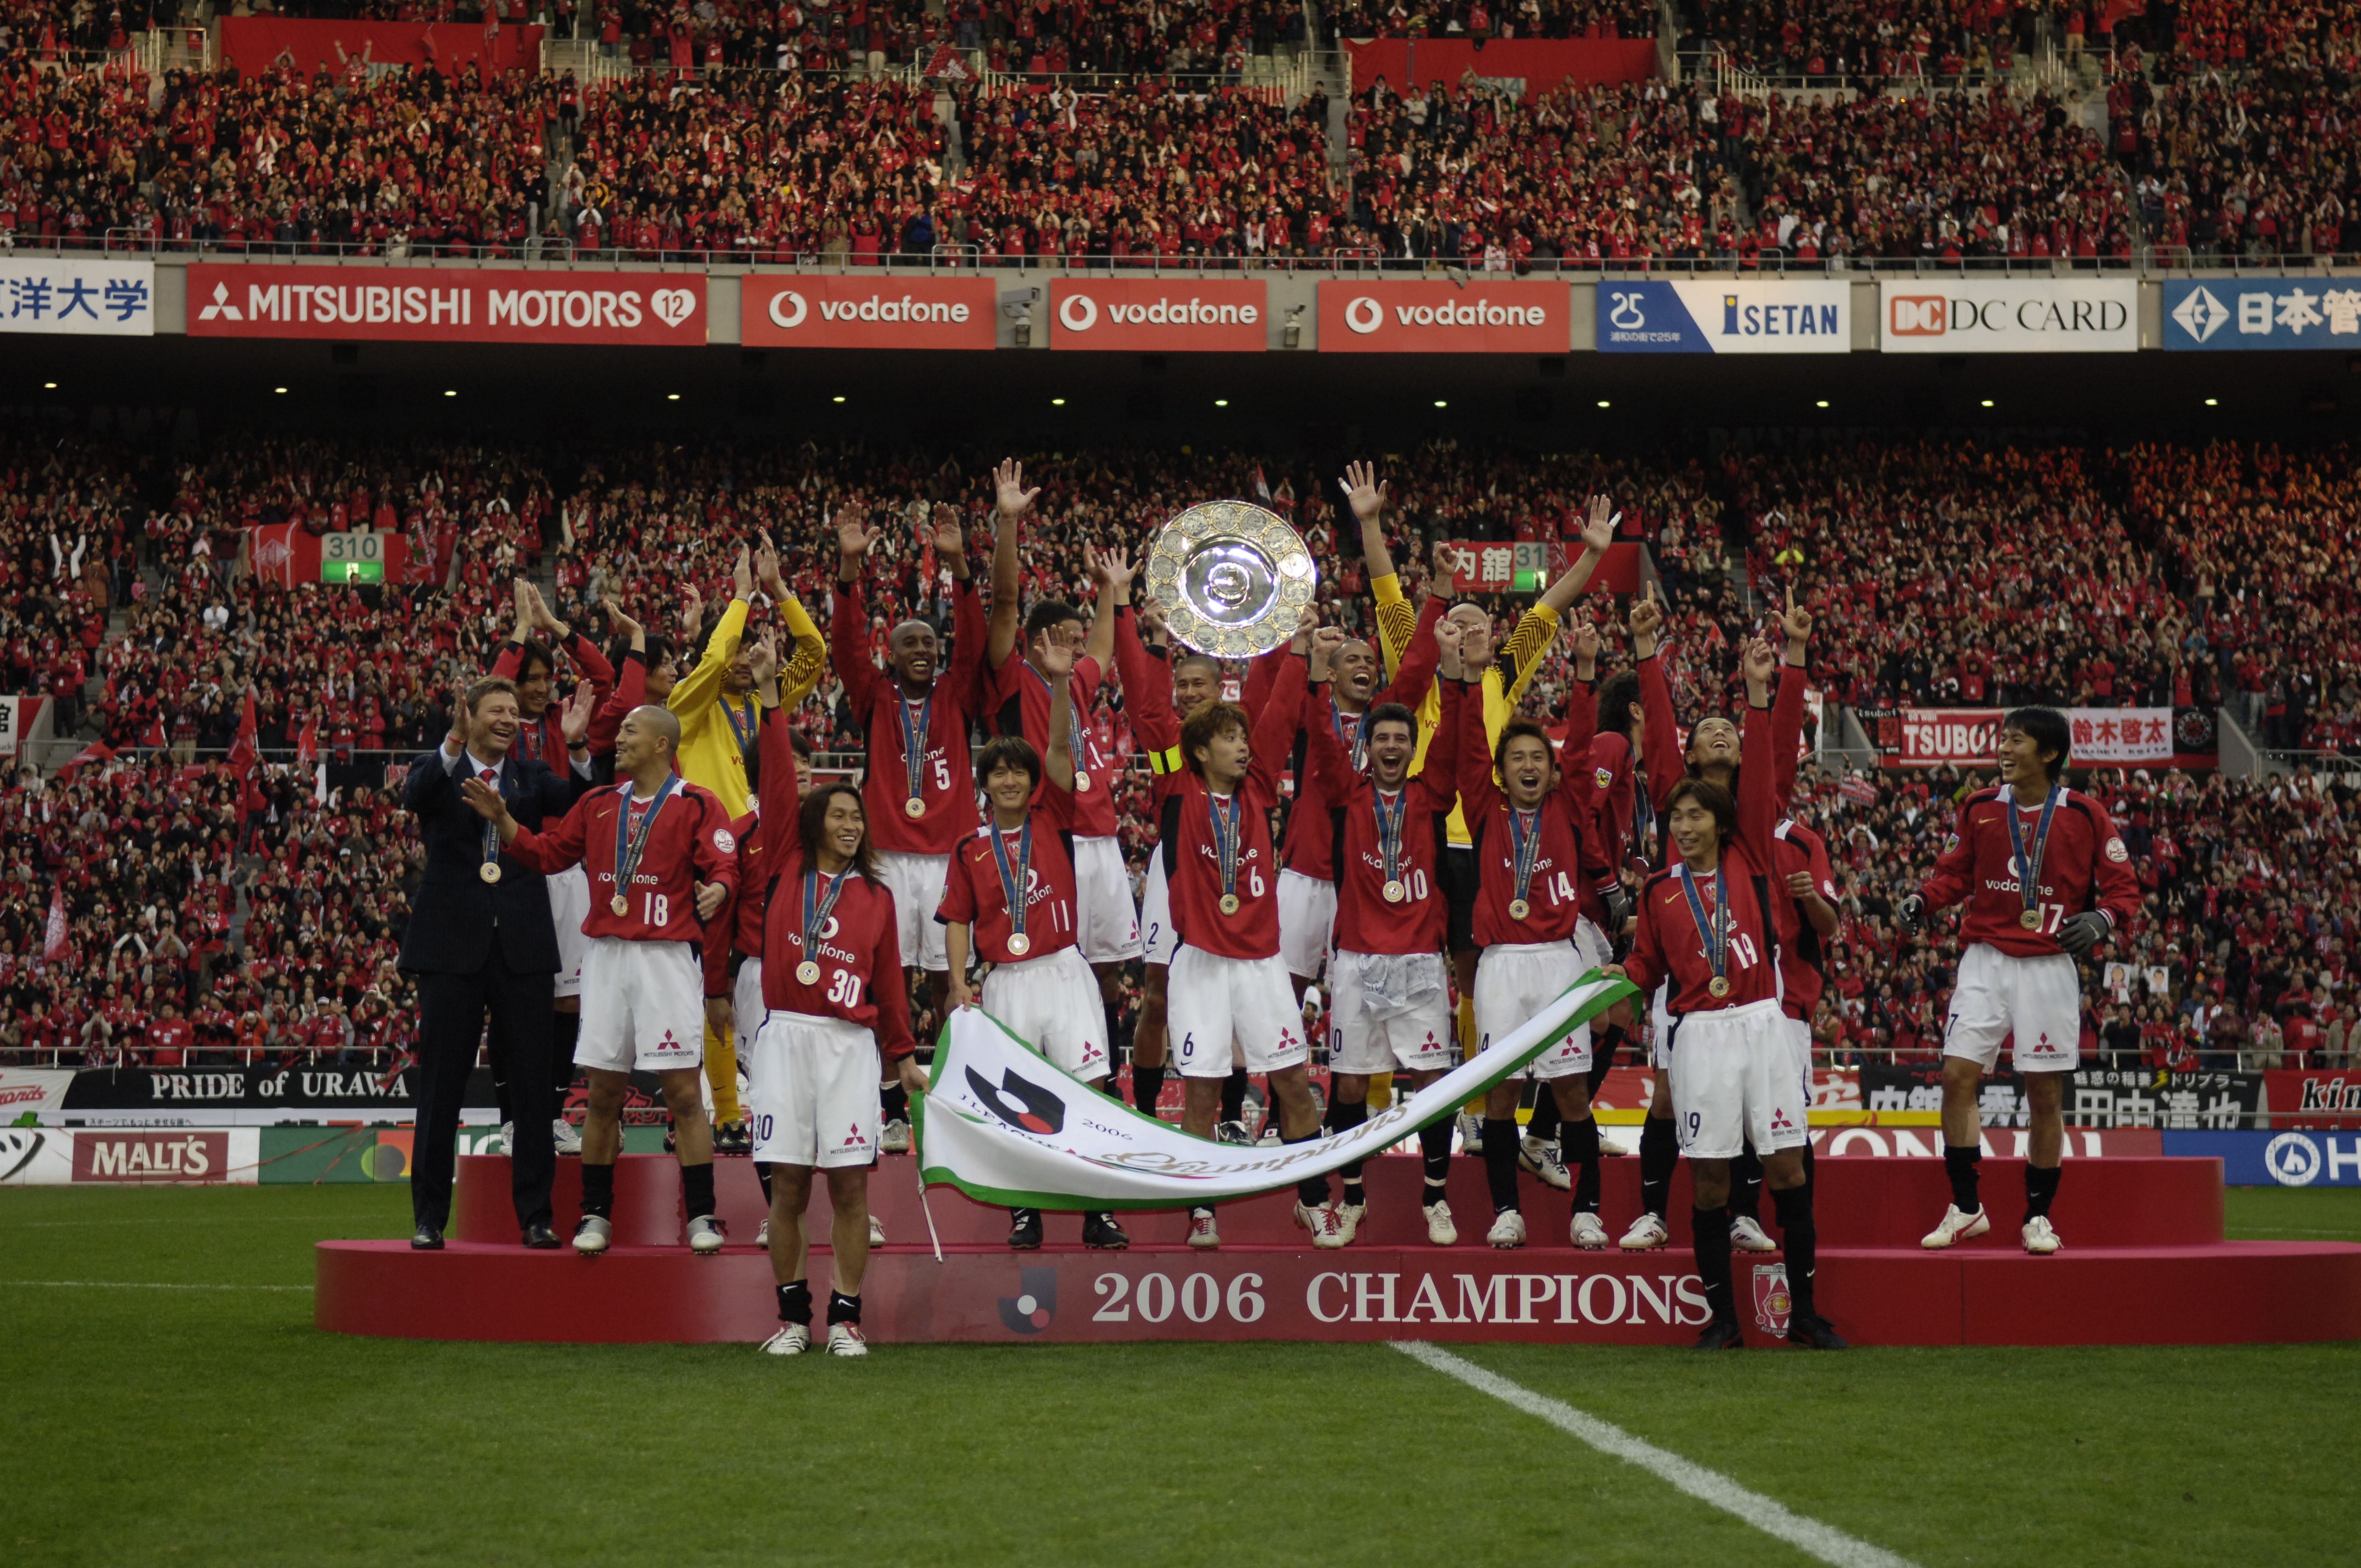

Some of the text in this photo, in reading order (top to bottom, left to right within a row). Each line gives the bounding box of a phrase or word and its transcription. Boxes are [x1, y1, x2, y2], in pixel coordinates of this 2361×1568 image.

[0, 277, 148, 321] 洋大学
[248, 284, 643, 328] MITSUBISHI MOTORS
[661, 296, 683, 319] 12
[819, 294, 970, 323] vodafone
[1108, 297, 1258, 325] vodafone
[1396, 298, 1546, 326] vodafone
[2238, 287, 2361, 335] 日本管
[1951, 299, 2128, 331] DC CARD
[329, 536, 378, 559] 310
[1516, 546, 1543, 567] 31
[1906, 711, 1918, 722] ed
[2072, 717, 2166, 745] 鈴木啓太
[1903, 725, 1996, 756] TSUBOI
[934, 759, 950, 790] 5
[1250, 865, 1265, 897] 6
[1404, 868, 1428, 903] 10
[1548, 871, 1575, 906] 14
[1985, 879, 2053, 896] vodane
[644, 892, 668, 927] 18
[1051, 900, 1070, 933] 11
[2036, 903, 2064, 934] 17
[1731, 933, 1759, 969] 19
[828, 968, 861, 1008] 30
[1183, 1032, 1194, 1057] 6
[1267, 1049, 1293, 1059] MITSUBISHI
[151, 1070, 410, 1099] PRIDE of URAWA
[2073, 1070, 2248, 1090] 魅惑の稲妻 ドリブラー
[2075, 1088, 2242, 1130] 田中達也
[756, 1114, 773, 1141] 30
[1082, 1119, 1133, 1140] 2006
[830, 1147, 859, 1156] MITSUBISHI
[1092, 1272, 1713, 1326] 2006 CHAMPIONS
